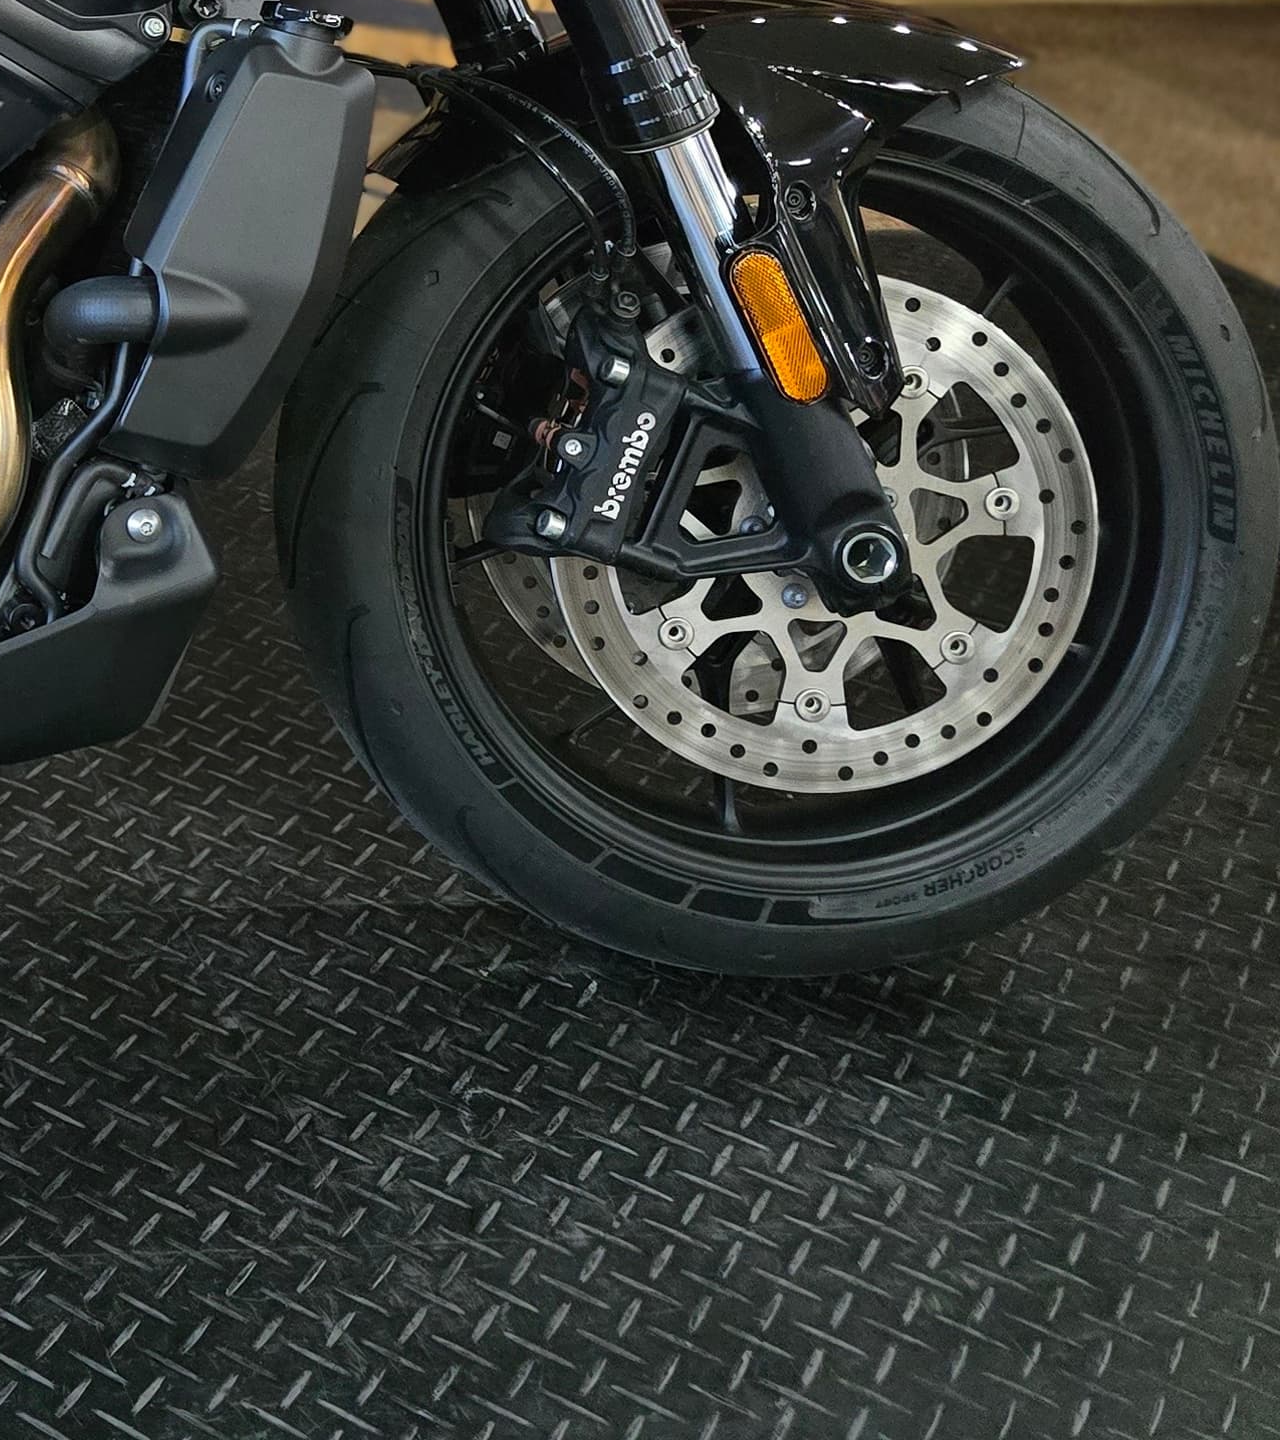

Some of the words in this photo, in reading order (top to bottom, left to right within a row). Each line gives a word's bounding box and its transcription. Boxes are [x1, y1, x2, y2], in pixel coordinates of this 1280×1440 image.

[593, 411, 657, 520] brembo
[1166, 332, 1235, 532] MICHELIN
[923, 844, 1028, 899] SCORCHER
